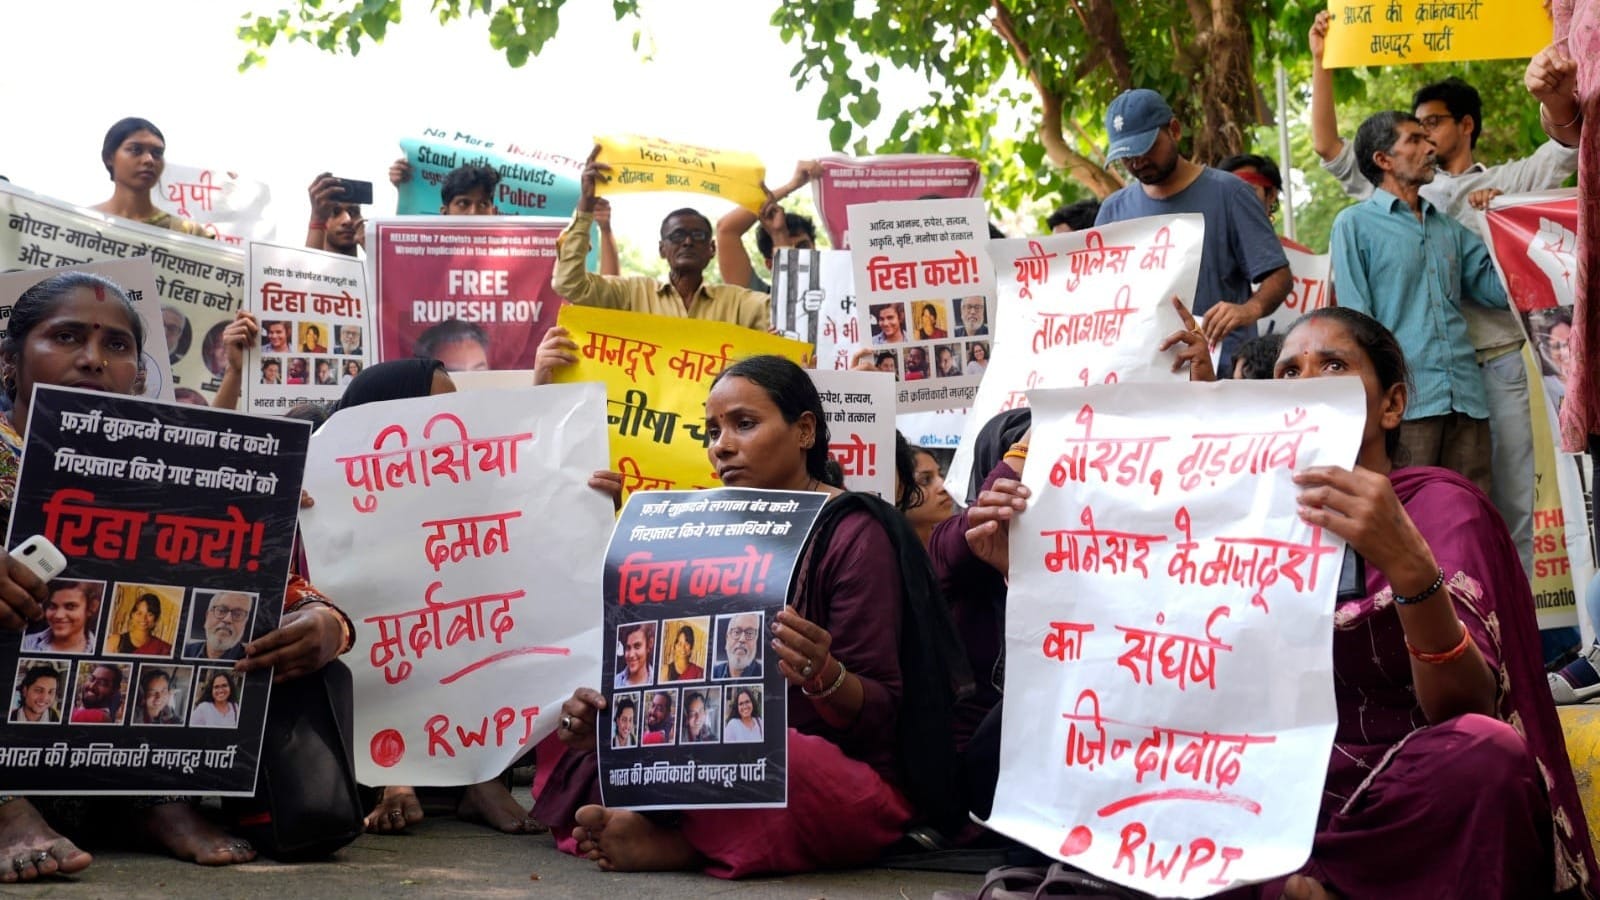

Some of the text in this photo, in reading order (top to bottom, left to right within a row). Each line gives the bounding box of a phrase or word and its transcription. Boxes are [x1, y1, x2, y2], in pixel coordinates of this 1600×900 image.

[1344, 5, 1375, 25] भारत
[1423, 25, 1455, 52] पार्टी
[418, 146, 456, 169] Stand
[500, 162, 557, 186] activists
[423, 127, 587, 171] No More INJUSTIC
[167, 170, 223, 218] यूपी
[500, 183, 547, 209] Police
[869, 218, 894, 231] आदित्य
[939, 231, 950, 242] को
[8, 212, 130, 258] नोएडा-मानेसर
[215, 267, 245, 289] मज़
[18, 243, 53, 268] और
[867, 249, 980, 292] रिहा करो!
[1013, 225, 1176, 300] यूपी पुलिस की
[263, 266, 285, 277] नोएडा
[286, 267, 294, 279] के
[448, 269, 509, 296] FREE
[168, 280, 202, 304] रिहा
[203, 292, 235, 312] करो
[260, 281, 362, 319] रिहा करो!
[413, 299, 543, 322] RUPESH ROY
[1031, 285, 1140, 355] तानाशाही
[582, 331, 663, 383] मज़दूर
[606, 389, 682, 445] नीषा
[834, 409, 846, 423] को
[847, 411, 876, 423] तत्काल
[844, 392, 873, 405] सत्यम,
[163, 424, 217, 449] लगाना
[218, 427, 242, 452] बंद
[243, 433, 280, 456] करो!
[828, 433, 877, 477] रो!
[129, 455, 166, 483] किये
[168, 463, 193, 485] गए
[194, 466, 256, 493] साथियों
[256, 472, 279, 495] को
[335, 412, 536, 514] पुलिसिया
[709, 501, 749, 513] लगाना
[749, 499, 769, 513] बंद
[768, 500, 800, 513] करो!
[42, 489, 266, 572] रिहा करो!
[421, 510, 523, 572] दमन
[677, 522, 704, 540] किये
[705, 524, 724, 537] गए
[725, 520, 772, 536] साथियों
[771, 519, 793, 536] को
[1040, 505, 1168, 579] मानेसर
[1533, 534, 1557, 554] RS
[616, 544, 775, 606] रिहा करो!
[1535, 587, 1576, 609] nizatio
[363, 581, 527, 684] मुर्दाबाद
[1043, 606, 1233, 691] का संघर्ष
[423, 706, 540, 757] RWPI
[1062, 689, 1277, 788] ज़िन्दाबाद
[0, 747, 43, 767] भारत
[44, 742, 68, 767] की
[151, 748, 202, 774] मज़दूर
[204, 744, 238, 769] पार्टी
[609, 768, 629, 787] भारत
[630, 762, 643, 785] की
[697, 763, 738, 788] मज़दूर
[739, 757, 768, 782] पार्टी
[1112, 822, 1243, 885] RWPI
